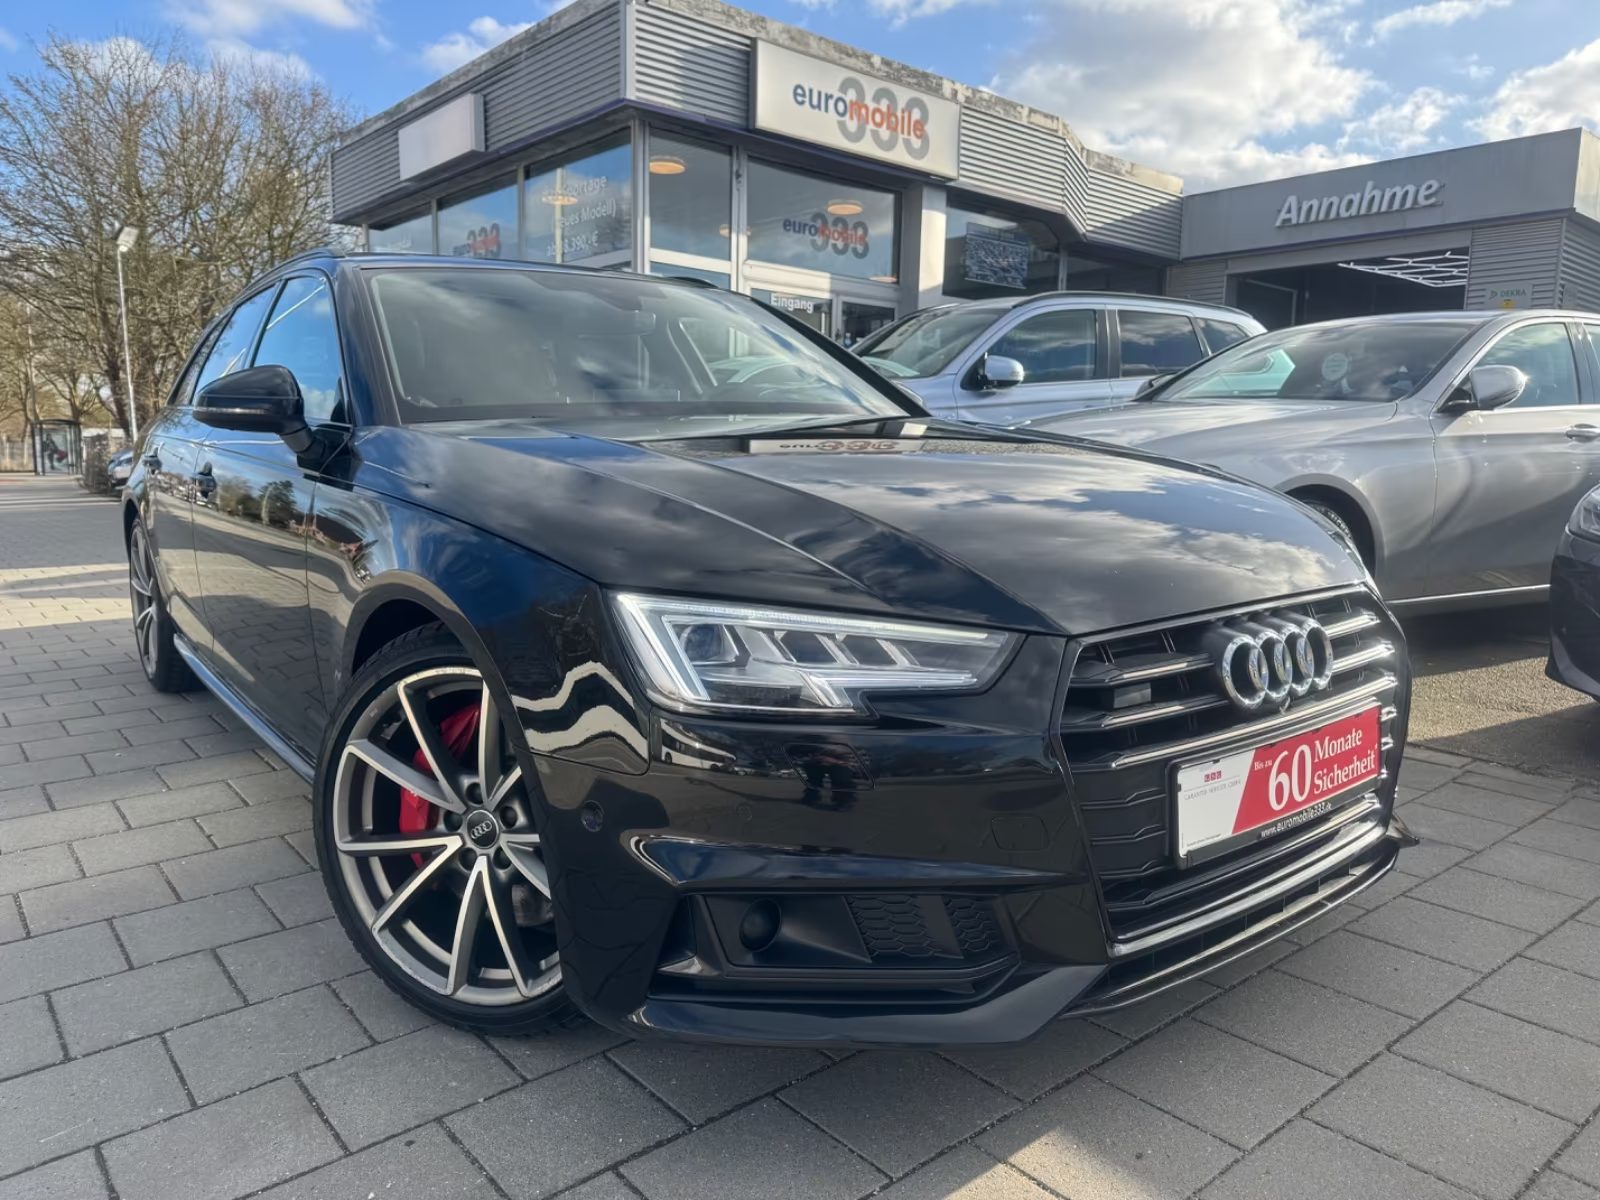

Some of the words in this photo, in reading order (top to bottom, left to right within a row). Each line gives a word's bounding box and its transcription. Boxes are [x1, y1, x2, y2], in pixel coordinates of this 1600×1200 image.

[792, 83, 926, 140] euromobile
[836, 76, 930, 160] 333
[1275, 179, 1441, 228] Annahme
[810, 212, 870, 260] 333
[770, 292, 814, 314] Eingang
[1500, 288, 1527, 298] DEKRA
[1313, 728, 1363, 763] Monate
[1268, 744, 1312, 811] 60
[1313, 749, 1376, 795] Sicherheit
